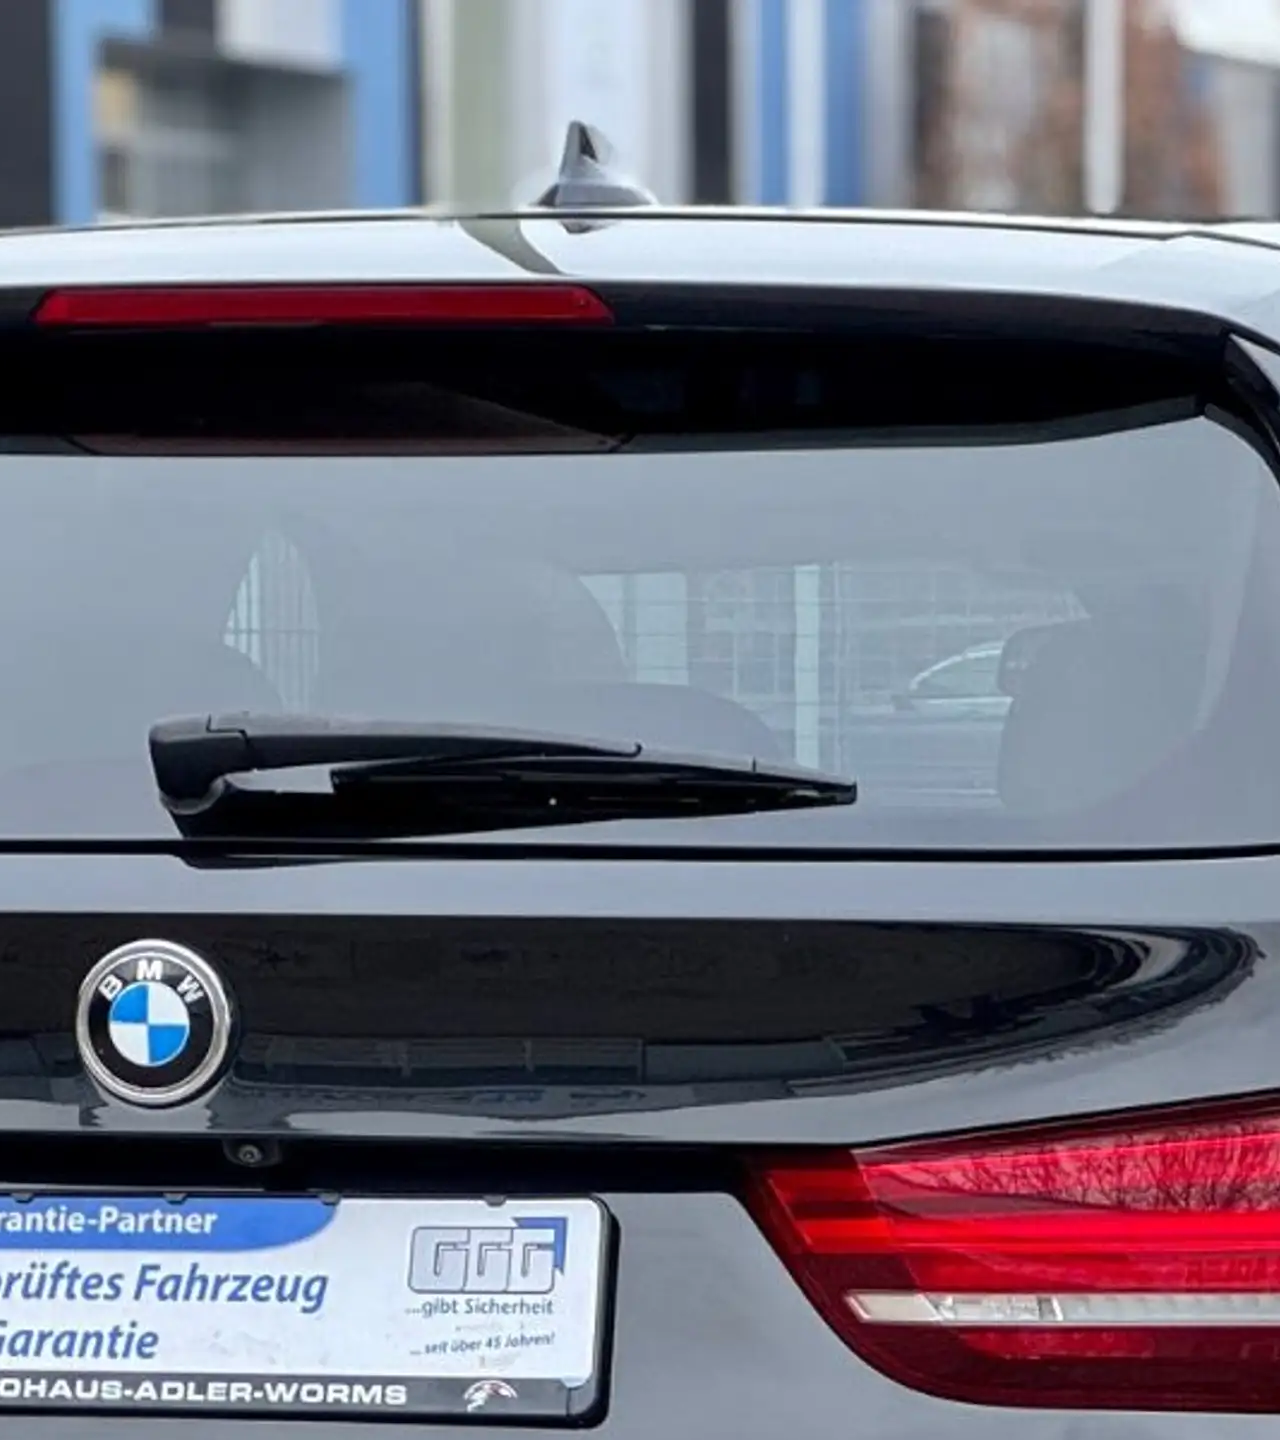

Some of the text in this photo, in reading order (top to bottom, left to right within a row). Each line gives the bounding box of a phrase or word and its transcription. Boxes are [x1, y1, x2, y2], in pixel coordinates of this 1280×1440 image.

[98, 960, 204, 1004] BMW
[133, 1263, 328, 1313] Fahrzeug
[464, 1299, 554, 1315] Sicherheit
[450, 1337, 482, 1352] über
[504, 1331, 556, 1350] Jahren!
